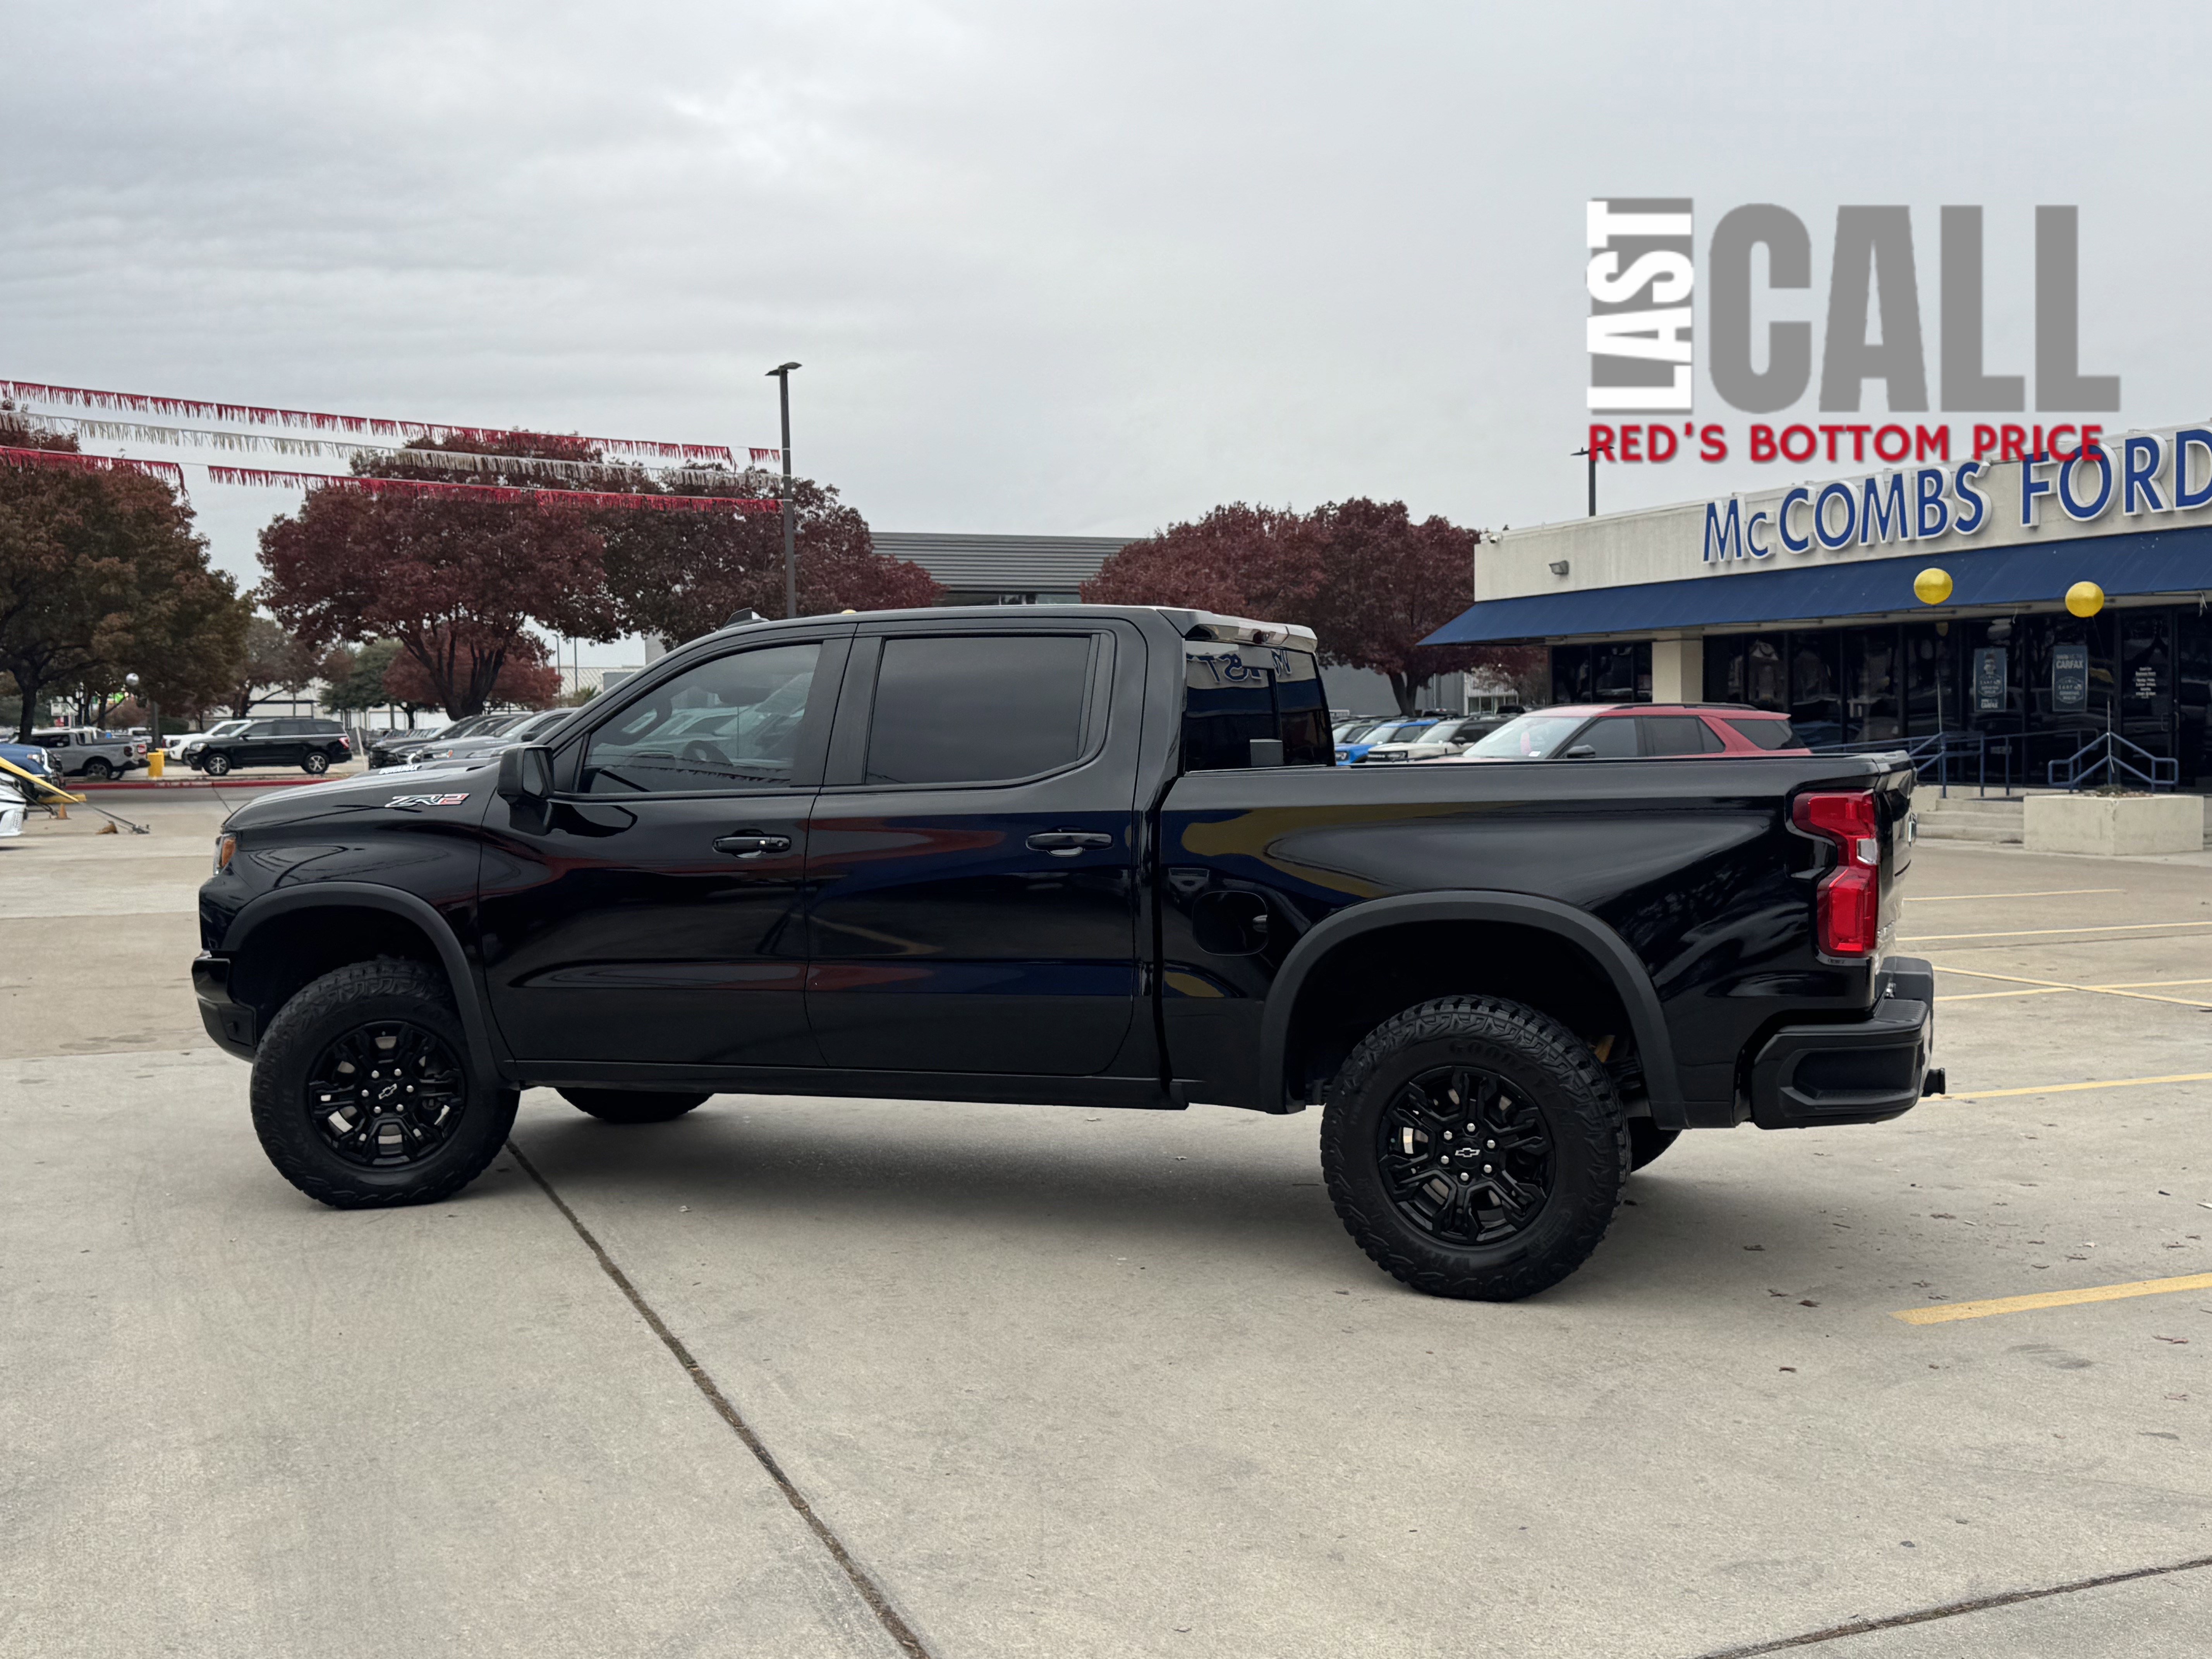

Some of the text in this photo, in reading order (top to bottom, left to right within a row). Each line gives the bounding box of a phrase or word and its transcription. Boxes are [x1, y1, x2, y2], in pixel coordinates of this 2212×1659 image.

[1704, 428, 2212, 564] McCOMBS FORD
[385, 793, 471, 808] ZR2
